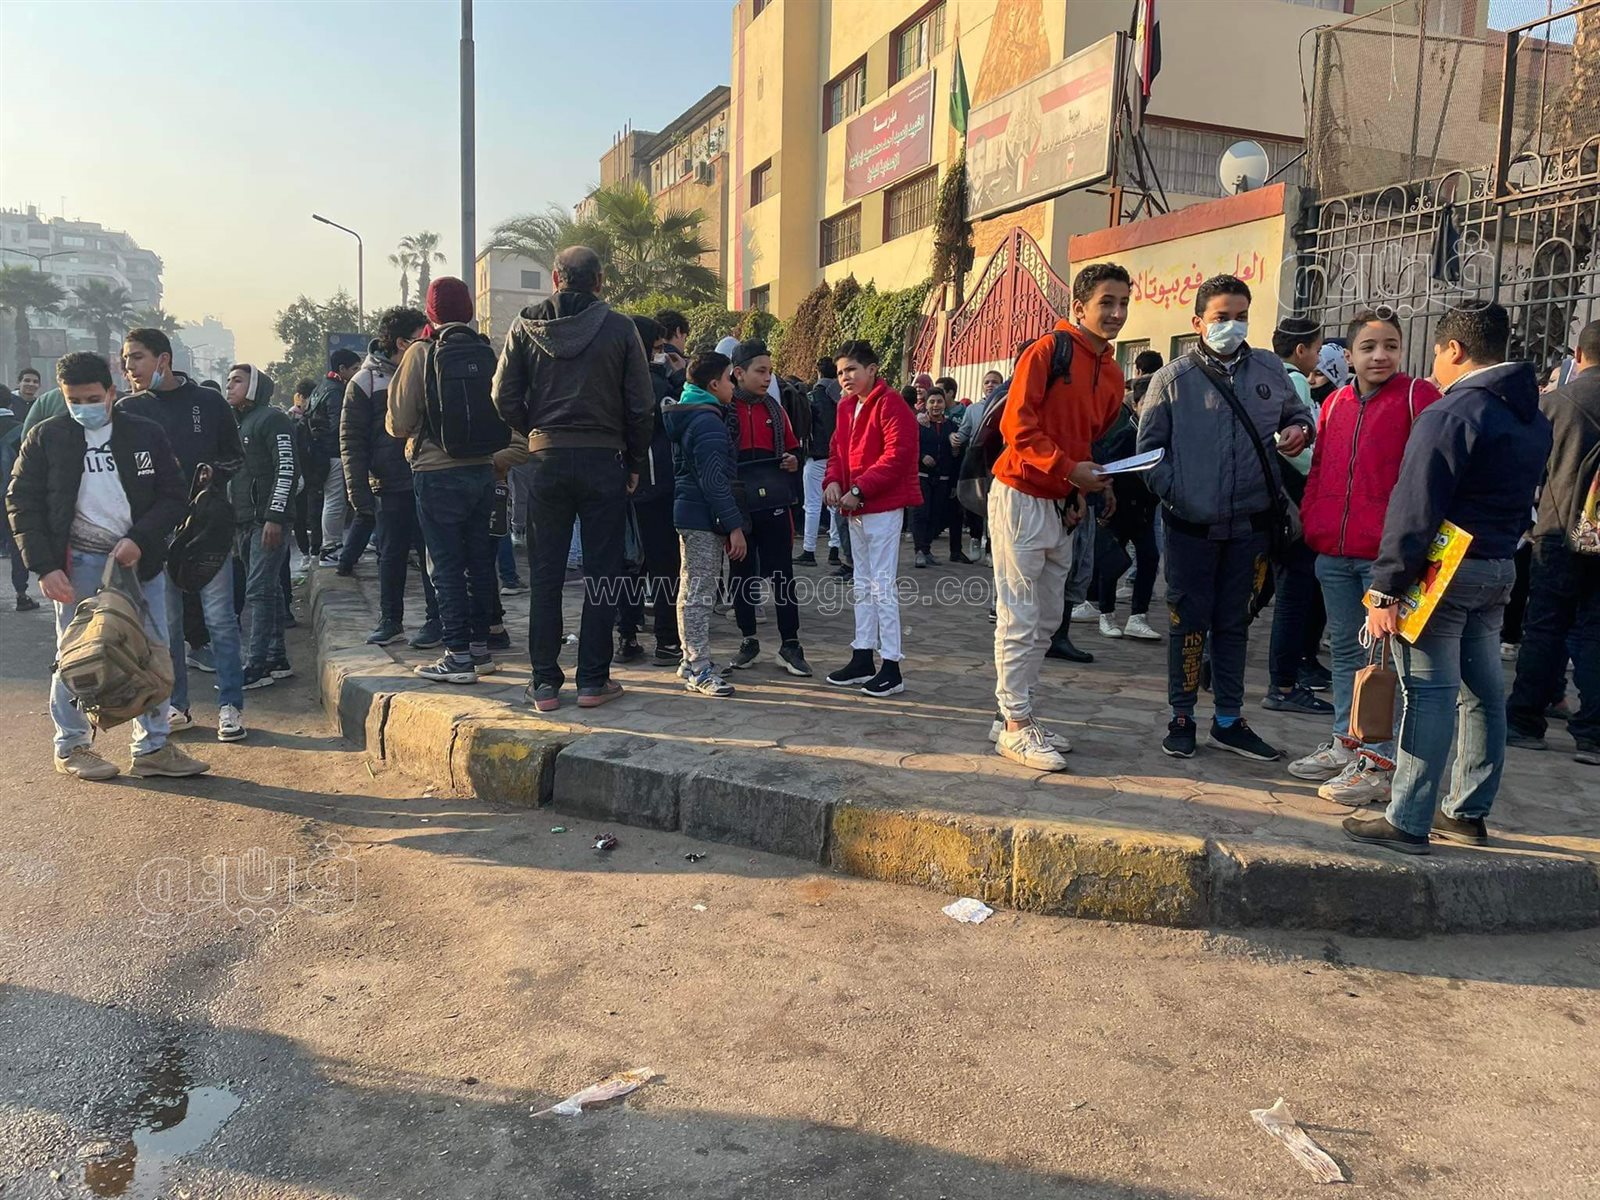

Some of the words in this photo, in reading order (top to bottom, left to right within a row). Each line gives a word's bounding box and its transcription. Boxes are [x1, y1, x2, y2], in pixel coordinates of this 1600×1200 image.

[1232, 251, 1265, 283] العل
[276, 434, 294, 476] CHICKEN
[269, 478, 293, 512] DINNER
